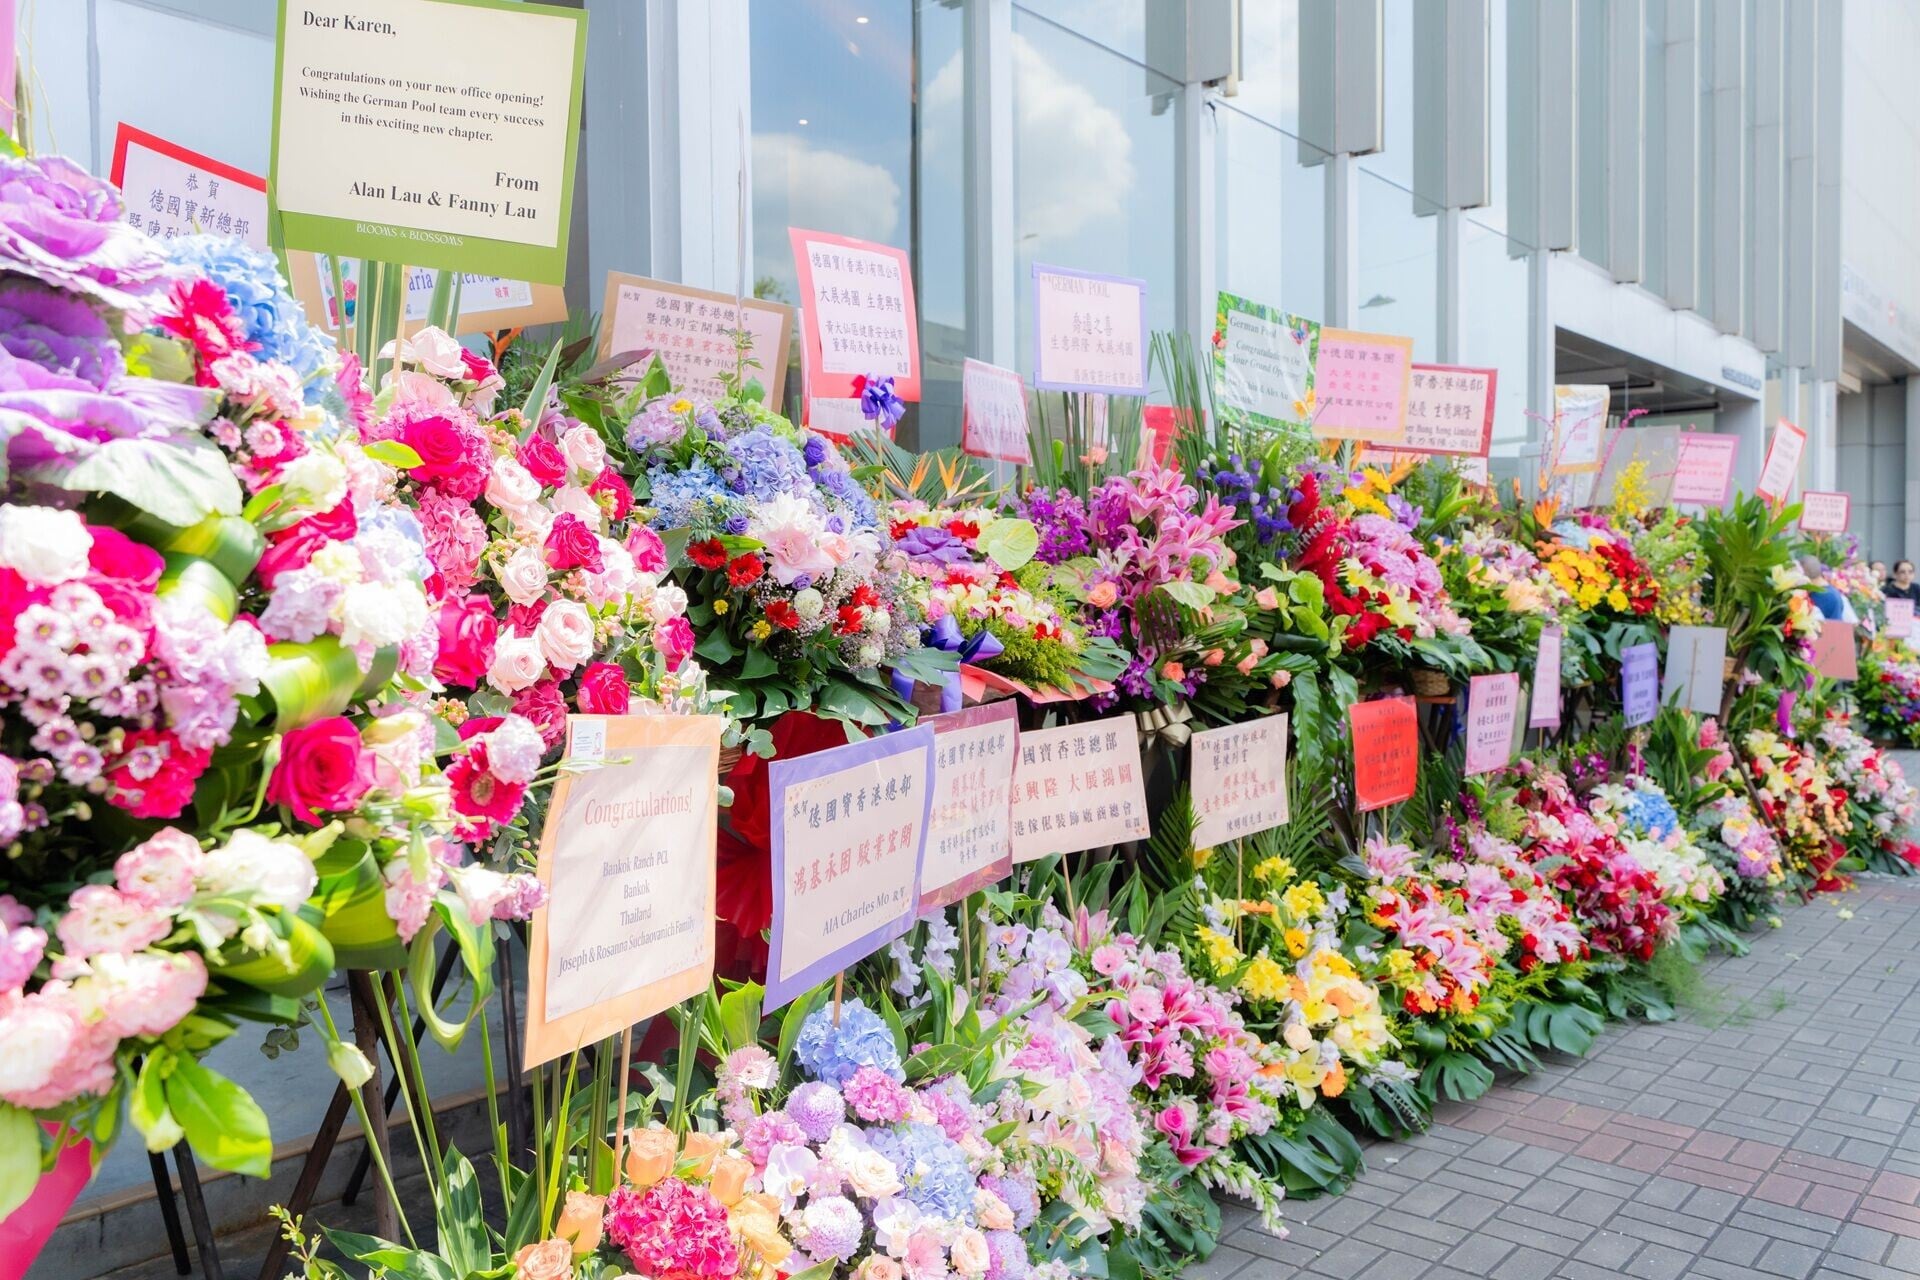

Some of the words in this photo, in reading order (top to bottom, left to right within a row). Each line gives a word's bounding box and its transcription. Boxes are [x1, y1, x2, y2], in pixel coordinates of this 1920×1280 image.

[303, 10, 339, 29] Dear
[344, 15, 397, 37] Karen,
[302, 66, 386, 87] Congratulations
[389, 78, 402, 88] on
[405, 80, 432, 92] your
[435, 83, 458, 95] new
[460, 84, 492, 99] office
[495, 92, 544, 107] opening!
[299, 86, 341, 103] Wishing
[343, 92, 360, 104] the
[362, 94, 408, 110] German
[411, 100, 436, 114] Pool
[439, 104, 467, 116] team
[470, 109, 500, 124] every
[503, 113, 545, 127] success
[341, 112, 351, 123] in
[354, 114, 373, 126] this
[376, 117, 420, 134] exciting
[423, 124, 445, 135] new
[448, 126, 493, 143] chapter.
[186, 173, 220, 200] 恭賀
[495, 171, 539, 192] From
[150, 189, 249, 239] 德國寶新總部
[349, 181, 386, 200] Alan
[391, 185, 422, 205] Lau
[427, 191, 443, 207] &
[448, 193, 500, 218] Fanny
[504, 201, 537, 220] Lau
[356, 223, 398, 238] BLOOMS
[409, 230, 464, 246] BLOSSOMS
[584, 788, 693, 828] Congratulations!
[603, 858, 631, 878] Bankok
[633, 851, 655, 871] Ranch
[623, 879, 650, 899] Bankok
[620, 904, 652, 926] Thailand
[840, 899, 875, 926] Charles
[876, 892, 890, 909] Mo
[558, 949, 588, 977] Joseph
[596, 939, 628, 961] Rosanna
